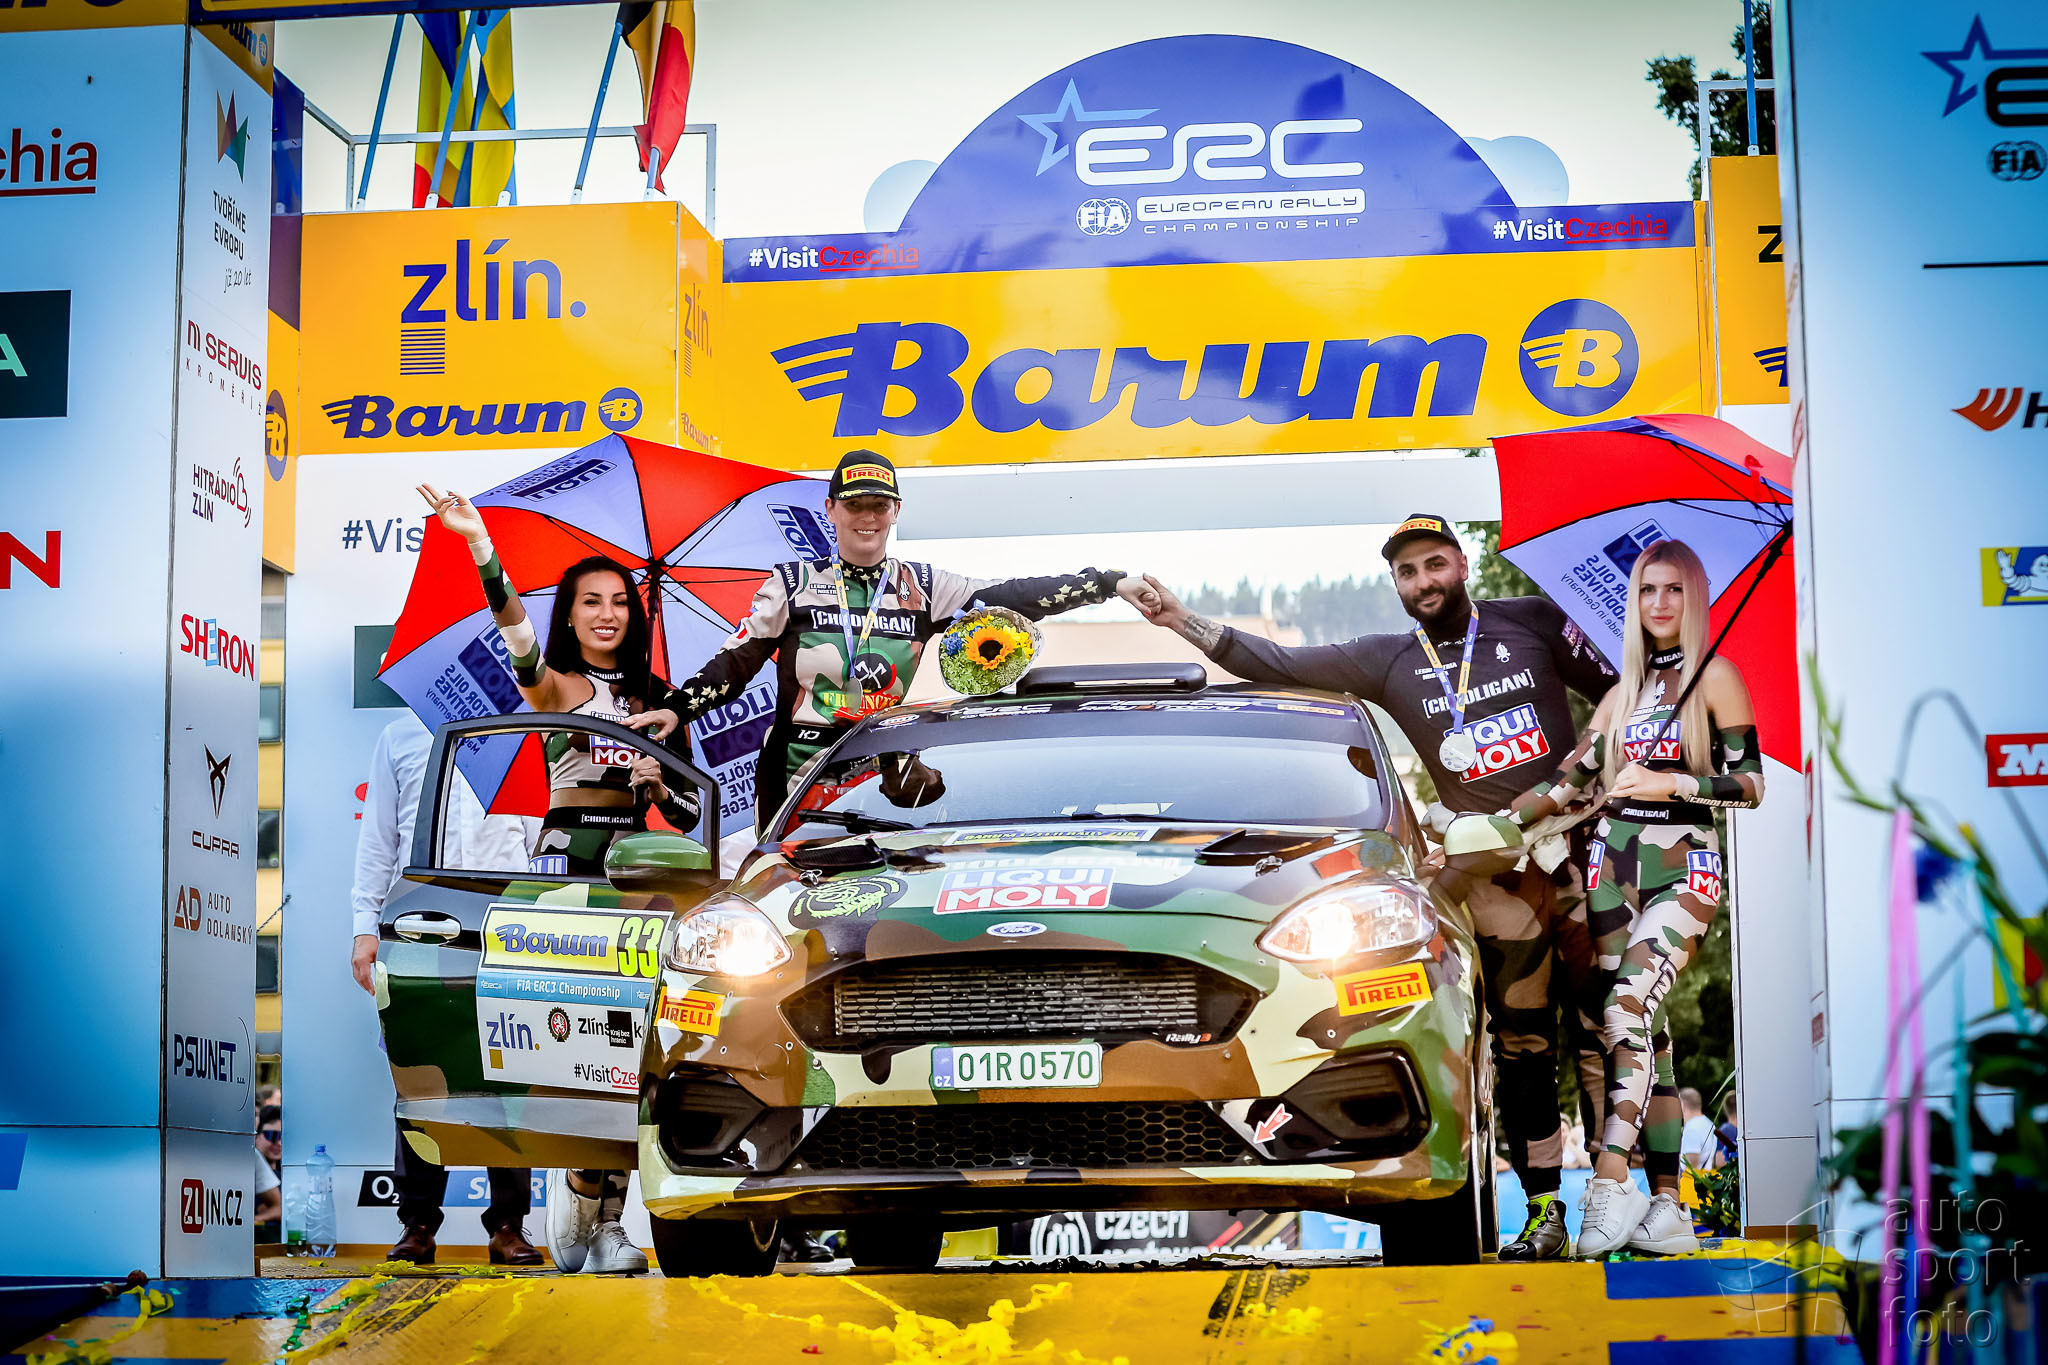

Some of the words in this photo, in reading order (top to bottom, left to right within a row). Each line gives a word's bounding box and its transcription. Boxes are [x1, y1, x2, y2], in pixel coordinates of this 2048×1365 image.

[0, 128, 97, 183] hia
[1075, 118, 1365, 186] ERC
[213, 189, 247, 234] TVOŘÍME
[1144, 198, 1274, 214] EUROPEAN
[1280, 194, 1358, 209] RALLY
[214, 222, 244, 260] EVROPU
[1144, 217, 1360, 234] CHAMPIONSHIP
[1493, 213, 1668, 241] #VisitCzechia
[749, 243, 919, 269] #VisitCzechia
[401, 238, 586, 324] zlín.
[770, 321, 1489, 437] Barum
[321, 394, 586, 438] Barum
[193, 463, 236, 507] HITRÁDIO
[845, 465, 891, 483] PIRELLI
[193, 491, 214, 522] ZLÍN
[180, 613, 255, 681] SHERON
[191, 830, 240, 859] CUPRA
[951, 868, 1106, 889] LIQUI
[207, 892, 231, 914] AUTO
[947, 885, 1108, 911] MOLY
[207, 918, 253, 945] DOLANSKÝ
[495, 923, 609, 957] Barum
[617, 916, 665, 978] 33
[516, 979, 531, 992] FIA
[533, 980, 557, 993] ERC3
[559, 981, 621, 1000] Championship
[1344, 972, 1422, 1006] PIRELLI
[578, 1017, 611, 1036] Zlíns
[660, 995, 716, 1027] PIRELLI
[486, 1012, 540, 1050] zlín.
[958, 1052, 1012, 1081] 01R
[1020, 1050, 1093, 1081] 0570
[934, 1075, 951, 1088] CZ
[183, 1187, 243, 1226] ZLIN.CZ
